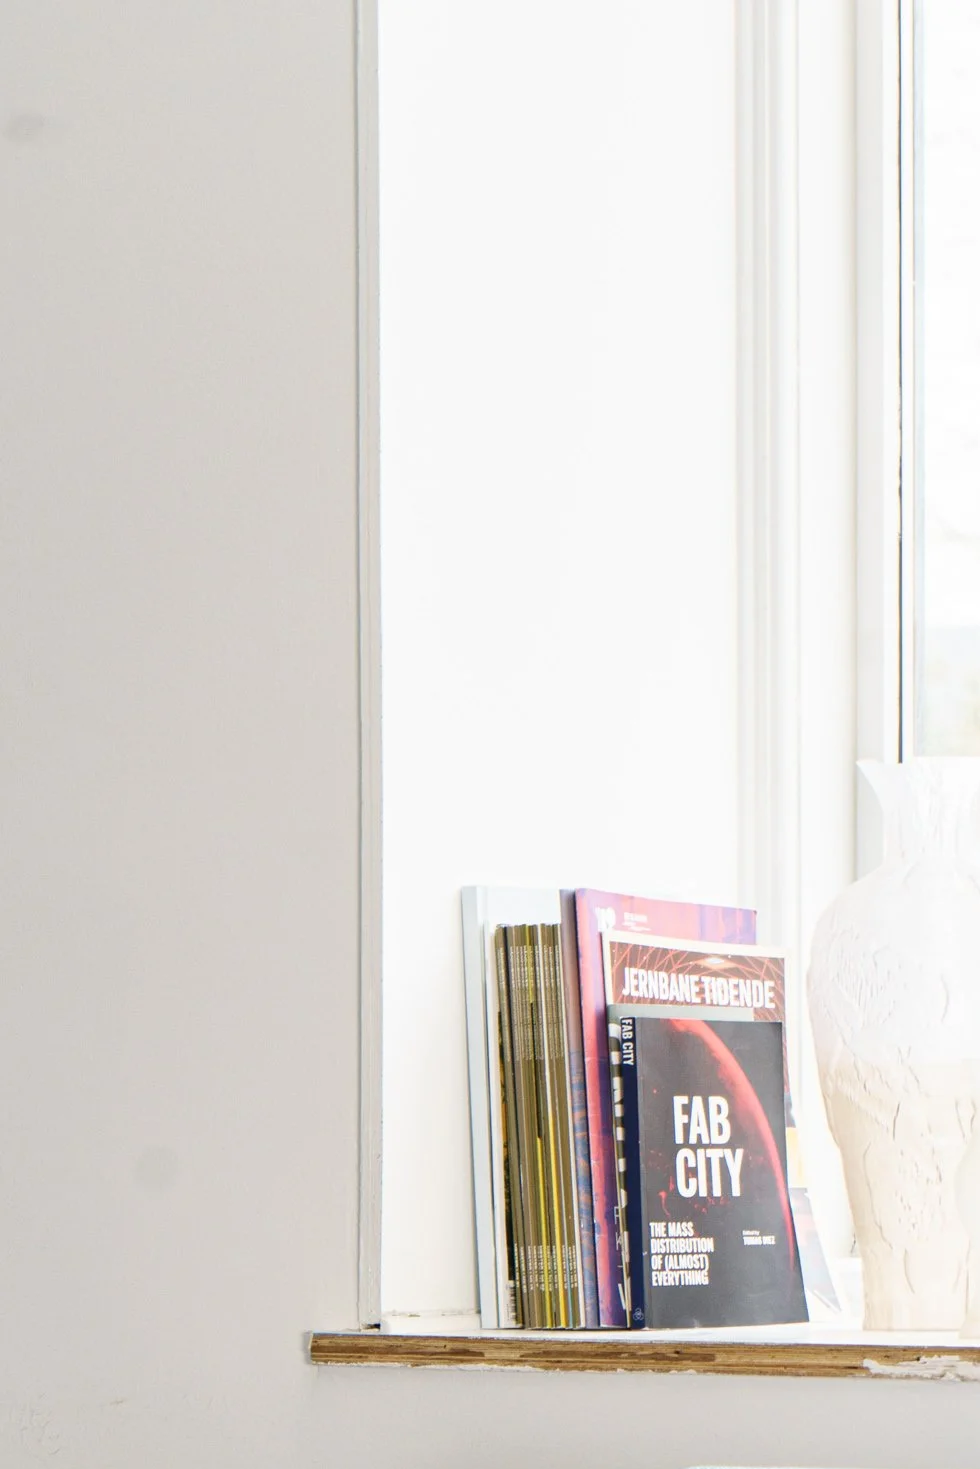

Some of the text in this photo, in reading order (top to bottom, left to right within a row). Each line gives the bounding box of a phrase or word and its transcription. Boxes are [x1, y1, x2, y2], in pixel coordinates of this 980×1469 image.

[621, 1018, 634, 1066] FAB CITY
[673, 1095, 731, 1144] FAB
[675, 1148, 744, 1197] CITY
[649, 1221, 694, 1237] THE MASS
[650, 1237, 714, 1253] DISTRIBUTION
[651, 1254, 709, 1271] OF (ALMOST)
[652, 1271, 709, 1286] EVERYTHING
